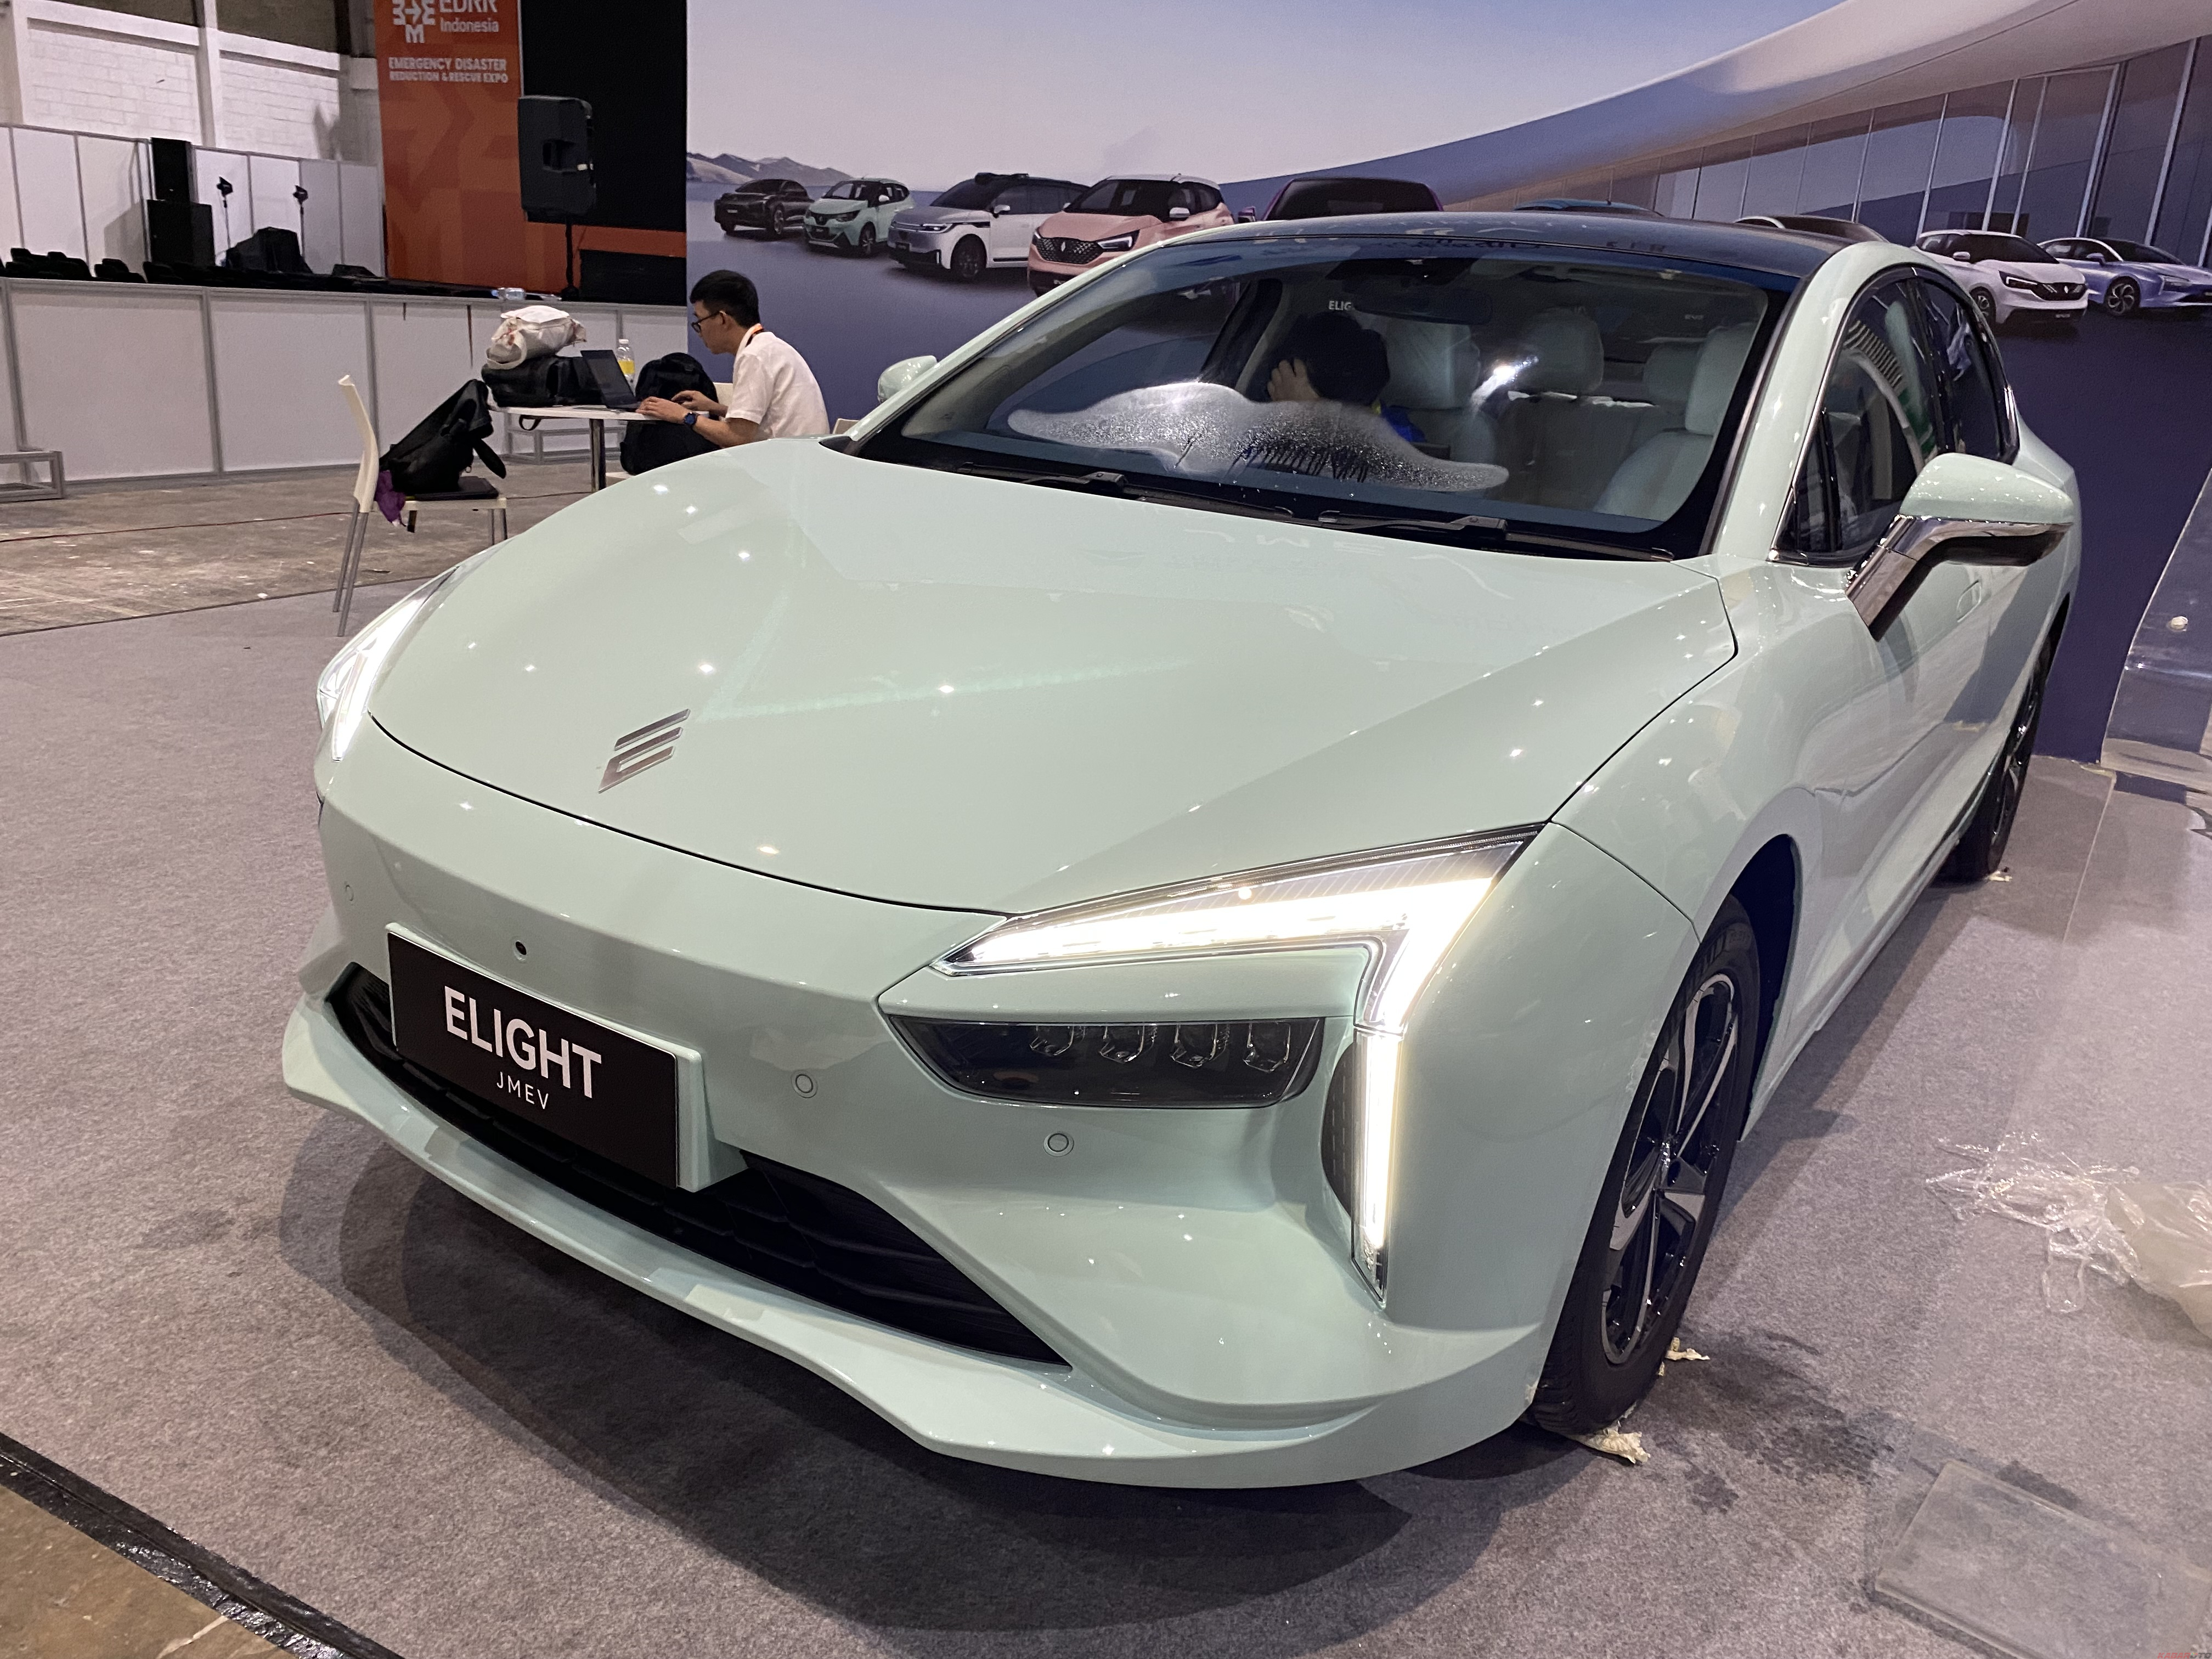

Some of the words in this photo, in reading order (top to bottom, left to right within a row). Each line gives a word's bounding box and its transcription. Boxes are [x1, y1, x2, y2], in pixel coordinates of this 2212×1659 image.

[440, 0, 498, 12] EDRR
[441, 18, 499, 32] Indonesia
[389, 57, 452, 70] EMERGENCY
[455, 58, 506, 71] DISASTER
[390, 71, 439, 81] REDUCTION
[449, 72, 481, 82] RESCUE
[483, 73, 508, 83] EXPO
[445, 985, 602, 1098] ELIGHT
[496, 1071, 549, 1110] JMEV
